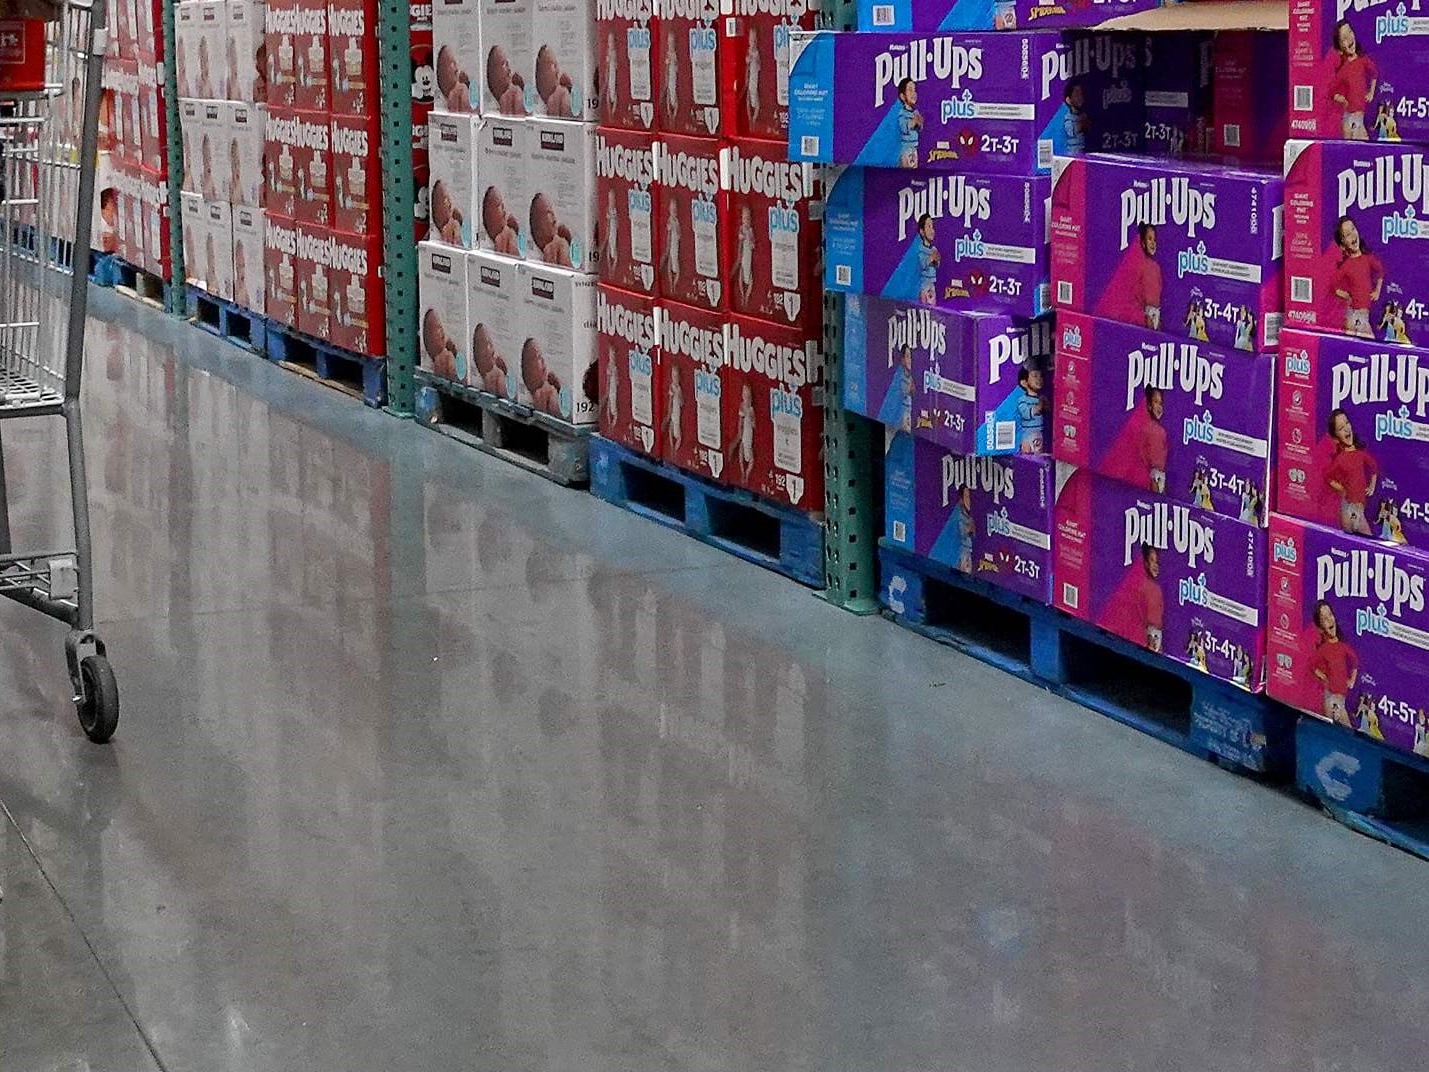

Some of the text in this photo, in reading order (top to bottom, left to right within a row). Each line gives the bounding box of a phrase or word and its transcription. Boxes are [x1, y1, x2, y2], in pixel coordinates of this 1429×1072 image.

[1376, 7, 1410, 44] plus
[587, 98, 599, 111] 19
[941, 93, 976, 124] plus
[596, 135, 653, 183] HUGGIES
[980, 134, 1020, 155] 2T-3T
[657, 140, 719, 195] HUGGIES
[727, 145, 803, 201] HUGGIES
[1382, 209, 1419, 244] plus
[588, 251, 600, 263] 19
[954, 232, 985, 263] plus
[1178, 245, 1209, 278] plus
[988, 275, 1023, 296] 2T-3T
[596, 290, 654, 347] HUGGIES
[1204, 297, 1240, 324] 3T-4T
[1406, 298, 1429, 320] 4T-
[658, 307, 724, 367] HUGGIES
[728, 323, 806, 387] HUGGIES
[576, 401, 595, 414] 192
[770, 384, 803, 418] plus
[944, 410, 966, 433] 2T-3T
[1182, 412, 1214, 444] plus
[1375, 408, 1412, 442] plus
[1209, 467, 1245, 495] 3T-4T
[1400, 497, 1429, 523] 4T-5
[1014, 555, 1041, 580] 2T-3T
[1178, 575, 1209, 606] plus
[1356, 604, 1390, 637] plus
[1205, 630, 1236, 659] 3T-4T
[1378, 694, 1417, 726] 4T-5T
